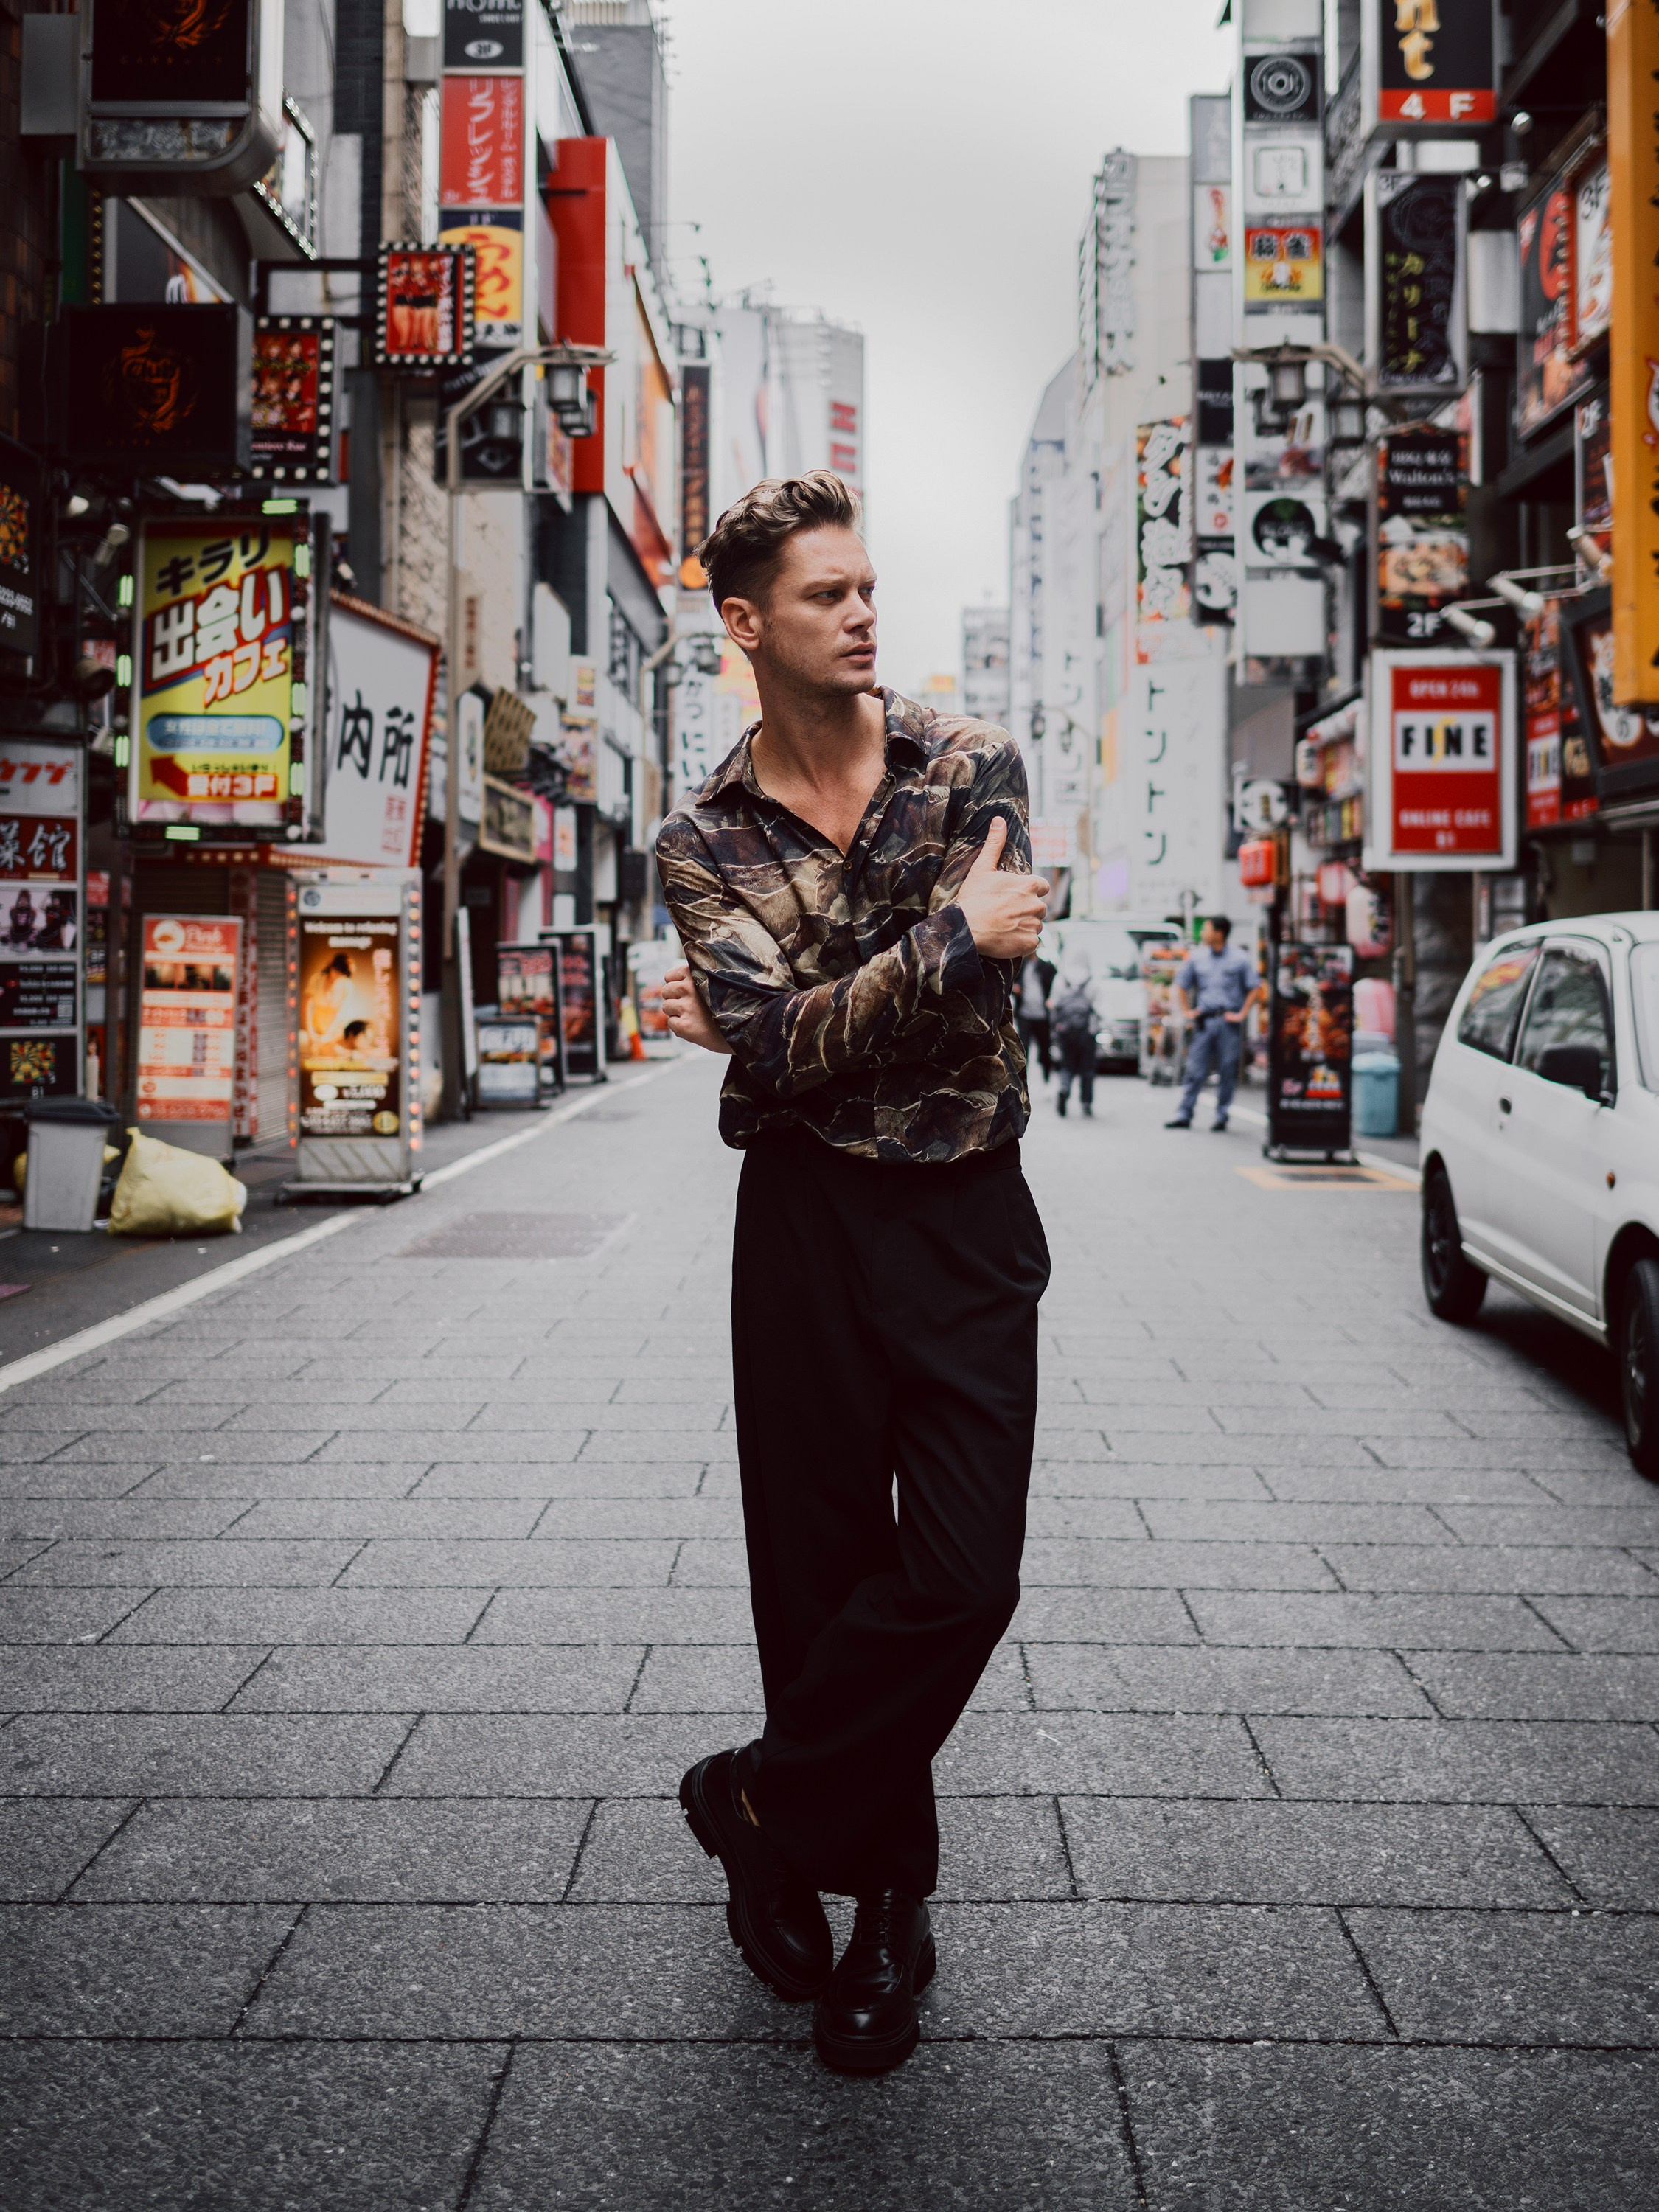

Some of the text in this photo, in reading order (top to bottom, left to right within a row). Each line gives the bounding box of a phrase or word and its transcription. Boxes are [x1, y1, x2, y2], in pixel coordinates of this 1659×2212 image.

[156, 526, 271, 596] キラリ
[151, 569, 283, 682] 出会い
[1406, 611, 1441, 639] 2F
[204, 639, 288, 708] カフェ
[1402, 726, 1489, 757] FINE
